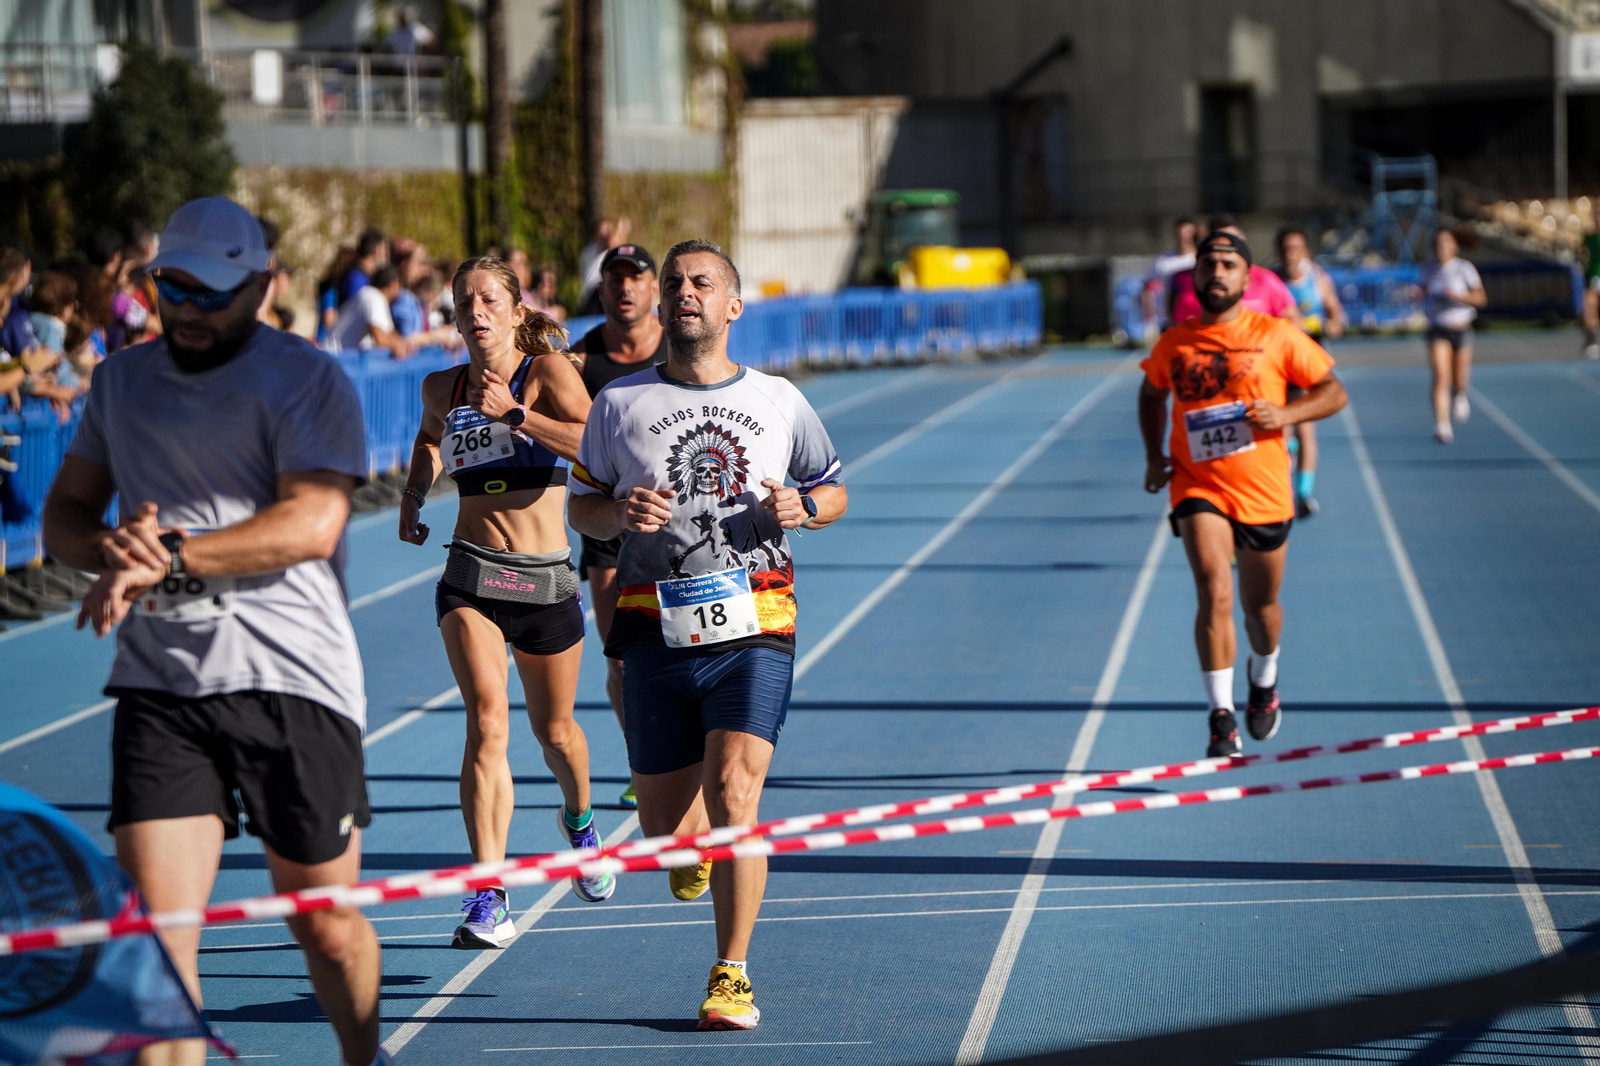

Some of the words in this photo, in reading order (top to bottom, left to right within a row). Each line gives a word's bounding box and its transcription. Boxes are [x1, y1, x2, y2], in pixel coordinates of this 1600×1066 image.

[702, 405, 764, 436] ROCKEROS
[451, 426, 493, 457] 268
[1201, 425, 1237, 448] 442
[679, 589, 703, 598] Ciudad
[714, 584, 732, 592] Jerez
[686, 579, 712, 588] Carrera
[713, 573, 738, 583] Popular
[693, 602, 728, 629] 18
